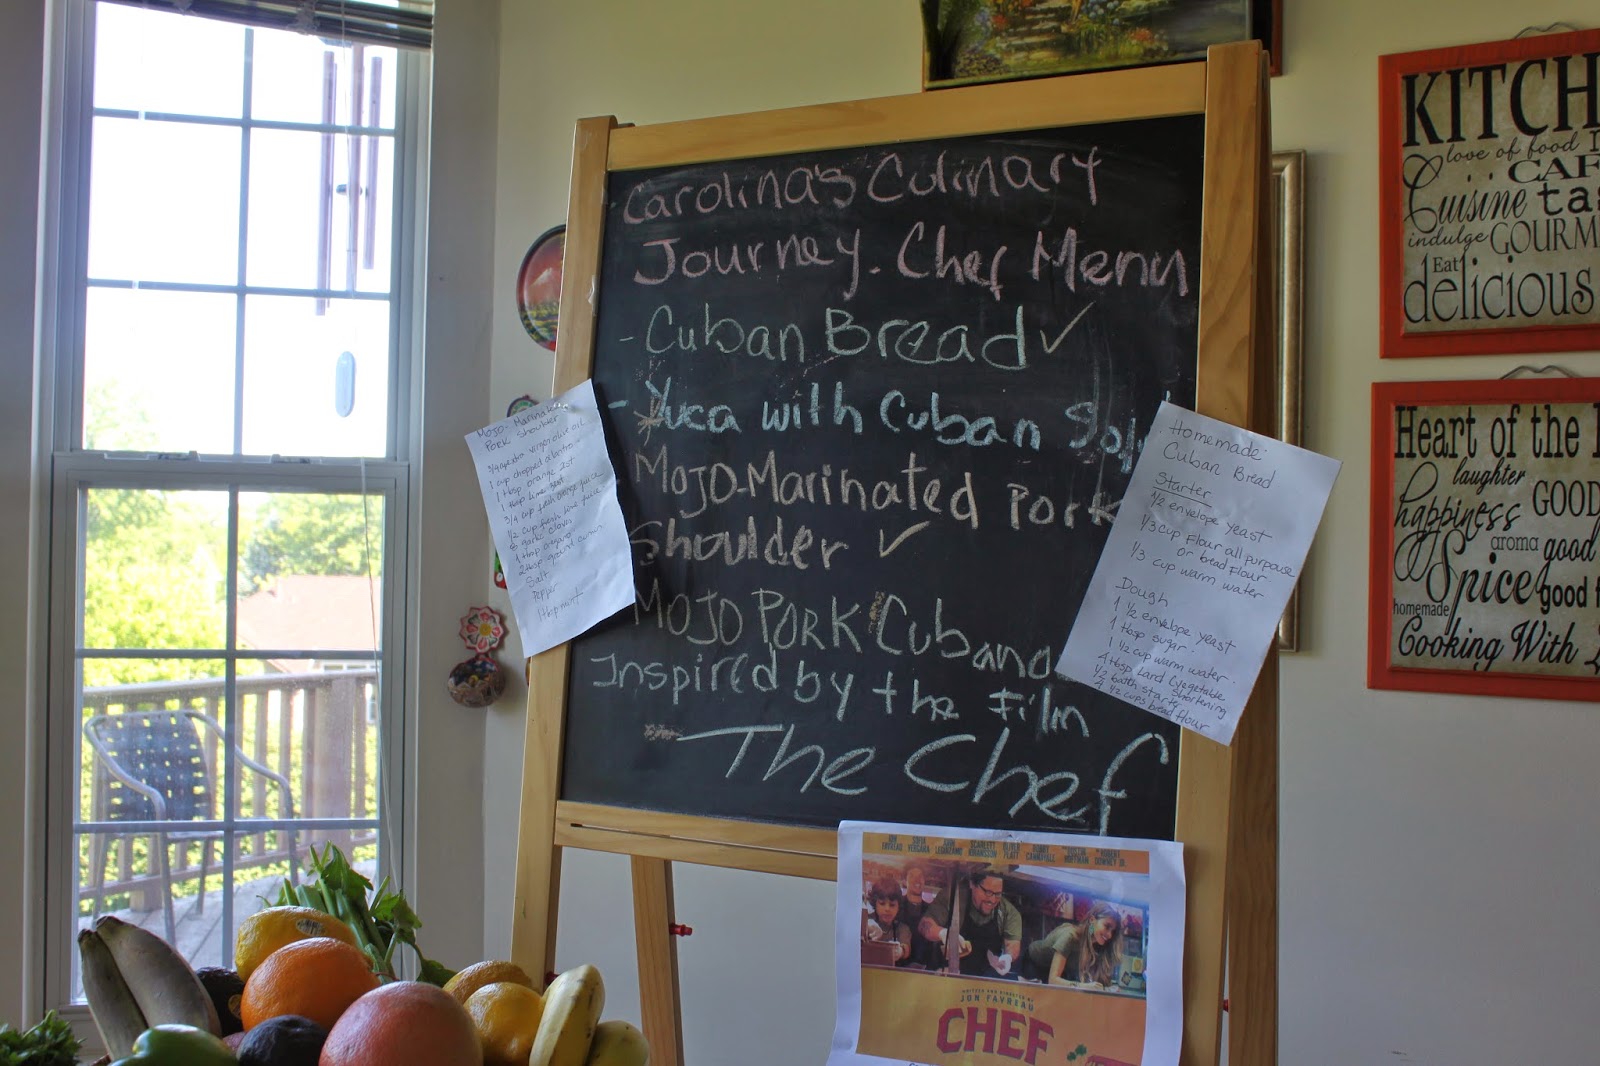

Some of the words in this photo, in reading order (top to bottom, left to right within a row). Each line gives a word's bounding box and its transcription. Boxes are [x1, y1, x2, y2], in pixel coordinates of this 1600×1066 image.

[1402, 52, 1600, 147] KITCH
[1446, 143, 1490, 163] love
[1496, 137, 1521, 161] of
[1527, 131, 1580, 159] food
[1508, 153, 1600, 183] CAF
[867, 146, 1102, 205] Culinary
[1402, 153, 1527, 234] Cuisine
[1537, 182, 1600, 216] ta
[1408, 225, 1489, 250] indulge
[1490, 215, 1600, 254] GOURM
[897, 221, 1007, 301] Chef
[1030, 227, 1188, 297] Menu
[1433, 257, 1460, 273] Eat
[1403, 250, 1594, 324] delicious
[645, 303, 804, 362] Cuban
[825, 305, 1026, 370] Bread
[645, 377, 742, 433] Yuca
[762, 381, 862, 433] with
[880, 390, 1040, 450] Cuban
[1394, 405, 1477, 458] Heart
[1490, 403, 1520, 458] of
[1530, 403, 1579, 458] the
[1169, 419, 1263, 461] Homemade
[1154, 471, 1213, 501] Starter
[1163, 442, 1220, 476] Cuban
[1233, 466, 1276, 489] Bread
[1452, 456, 1525, 495] laughter
[521, 508, 534, 519] cup
[1169, 502, 1219, 525] envelope
[1224, 521, 1273, 543] yeast
[1394, 461, 1520, 582] happiness
[630, 516, 848, 570] Shoulder
[1141, 514, 1156, 532] 1/3
[1225, 546, 1243, 560] all
[1490, 536, 1539, 551] aroma
[1130, 541, 1146, 561] 1/3
[1180, 568, 1216, 585] warm
[1223, 583, 1264, 599] water
[1199, 550, 1228, 571] bread
[1426, 529, 1538, 635] Spice
[1115, 577, 1168, 607] Dough
[1393, 598, 1449, 617] homemade
[1540, 576, 1587, 614] good
[751, 588, 862, 653] PORK
[1142, 612, 1191, 637] envelope
[1195, 632, 1237, 654] yeast
[1154, 657, 1184, 671] warm
[1399, 616, 1503, 671] Cooking
[1511, 619, 1578, 664] With
[591, 642, 777, 705] Inspired
[794, 660, 853, 721] by
[872, 671, 959, 722] the
[1142, 686, 1180, 708] starter
[1148, 702, 1173, 716] bread
[1176, 709, 1210, 730] flour
[676, 723, 876, 795] The
[904, 727, 1169, 836] Chef
[961, 994, 980, 1002] JON
[987, 994, 1034, 1011] FAVREAU
[936, 1007, 1054, 1066] CHEF
